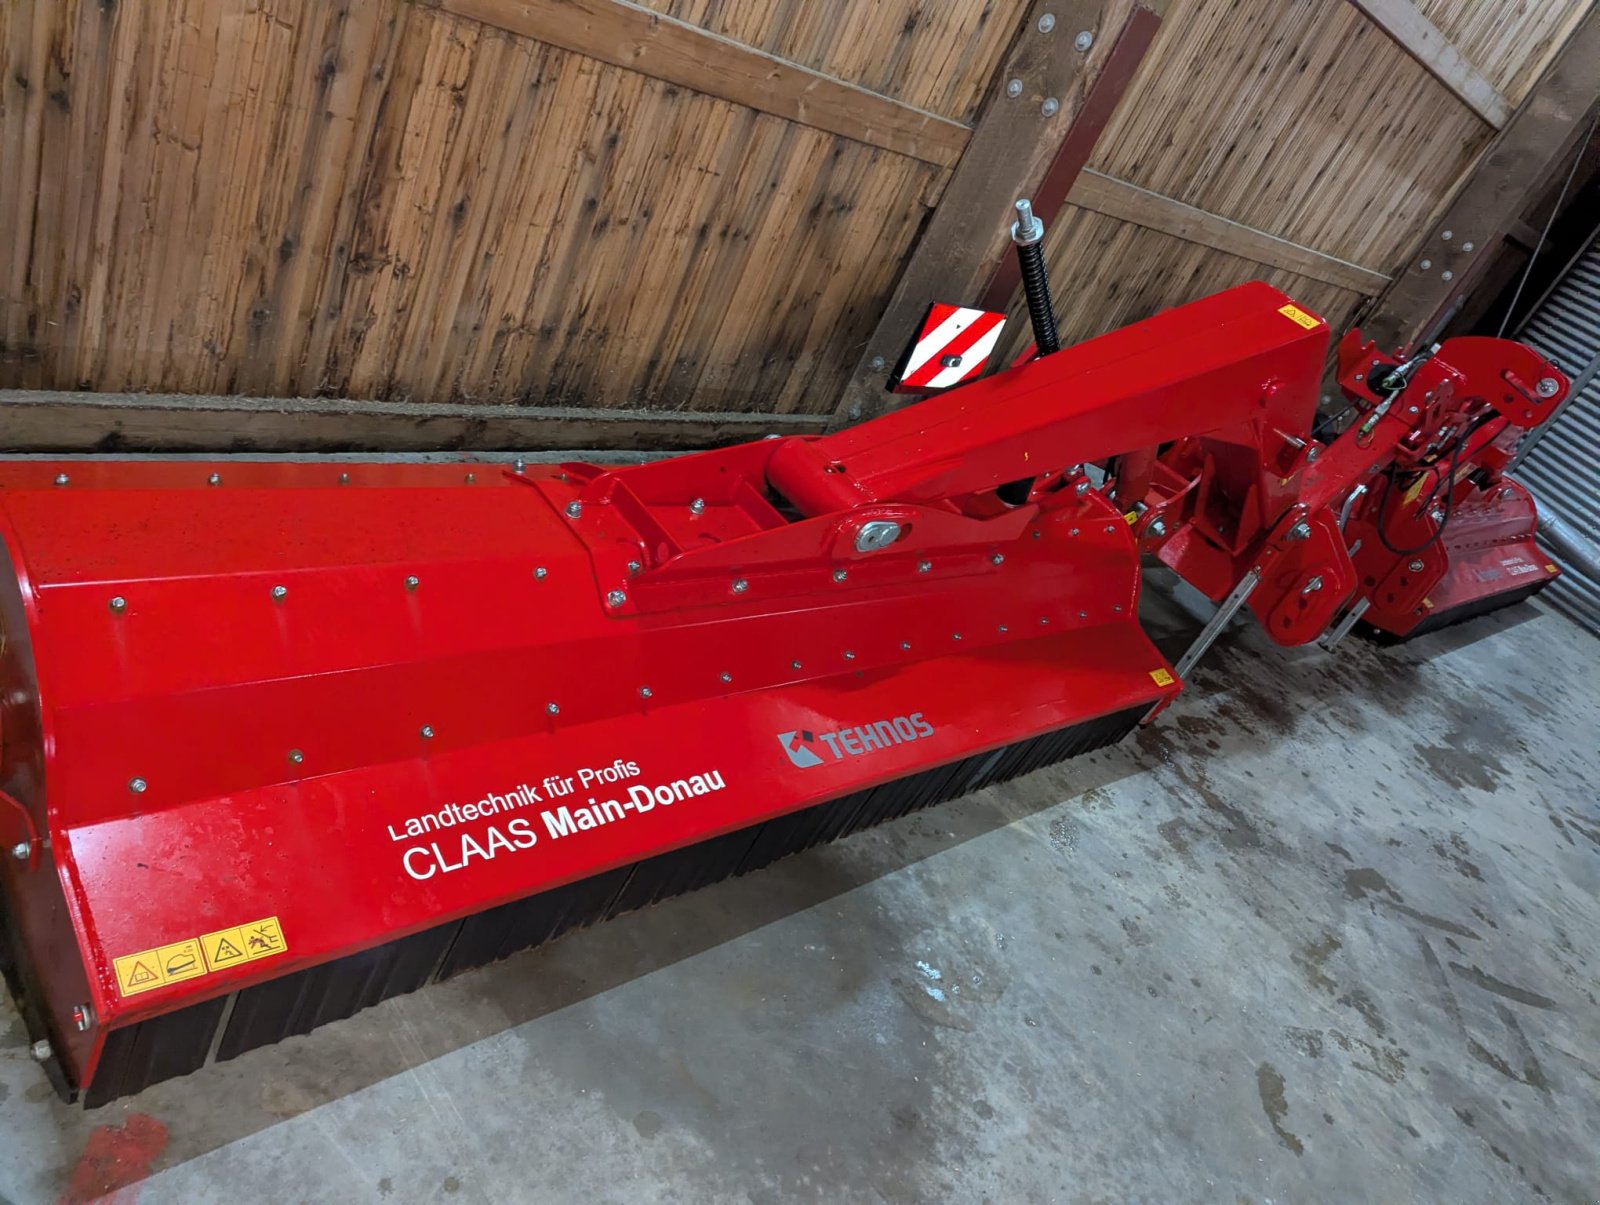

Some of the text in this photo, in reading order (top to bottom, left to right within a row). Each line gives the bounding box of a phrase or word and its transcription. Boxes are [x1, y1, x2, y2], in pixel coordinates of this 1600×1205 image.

[819, 712, 934, 759] TEHNOS
[388, 759, 640, 841] Landtechnik für Profis
[402, 769, 727, 880] CLAAS Main-Donau
